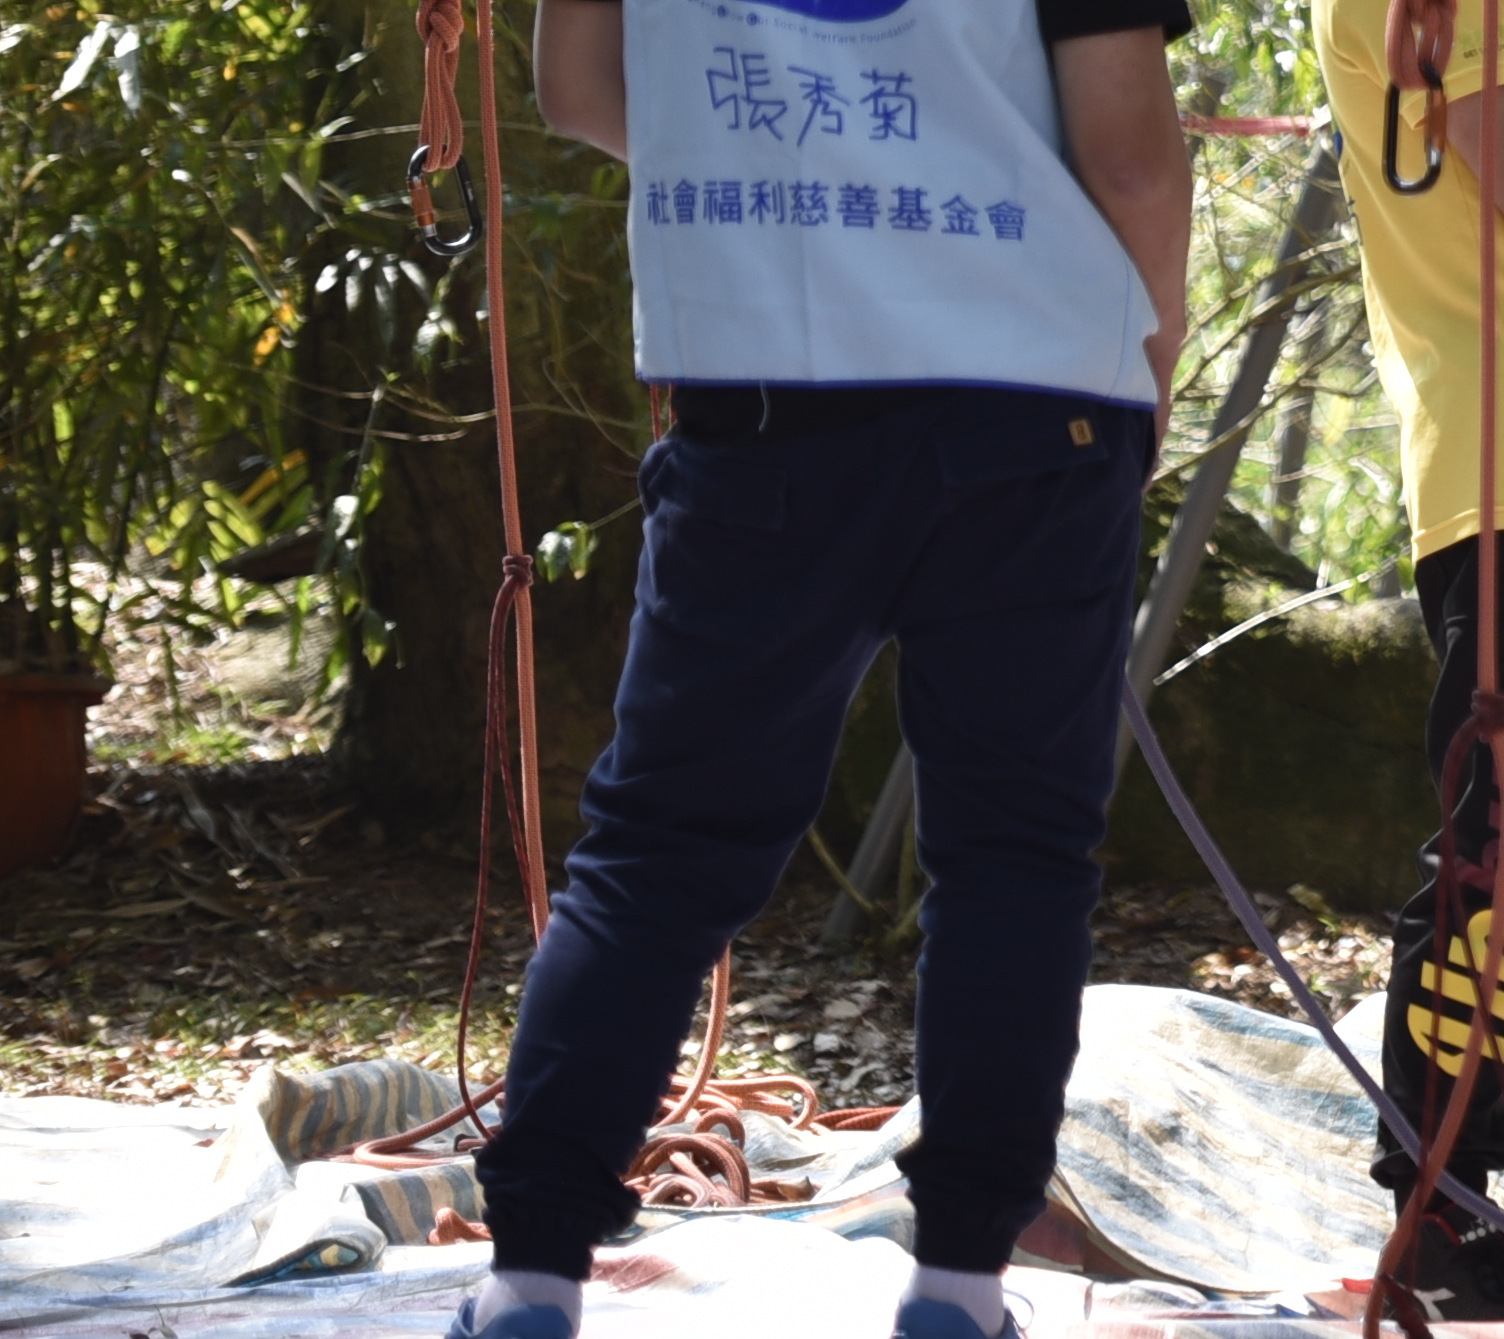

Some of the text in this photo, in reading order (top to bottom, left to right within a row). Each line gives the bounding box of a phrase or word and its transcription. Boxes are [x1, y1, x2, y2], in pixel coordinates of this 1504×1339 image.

[705, 46, 917, 147] 張秀菊
[646, 178, 1027, 242] 社會福利慈善基金會
